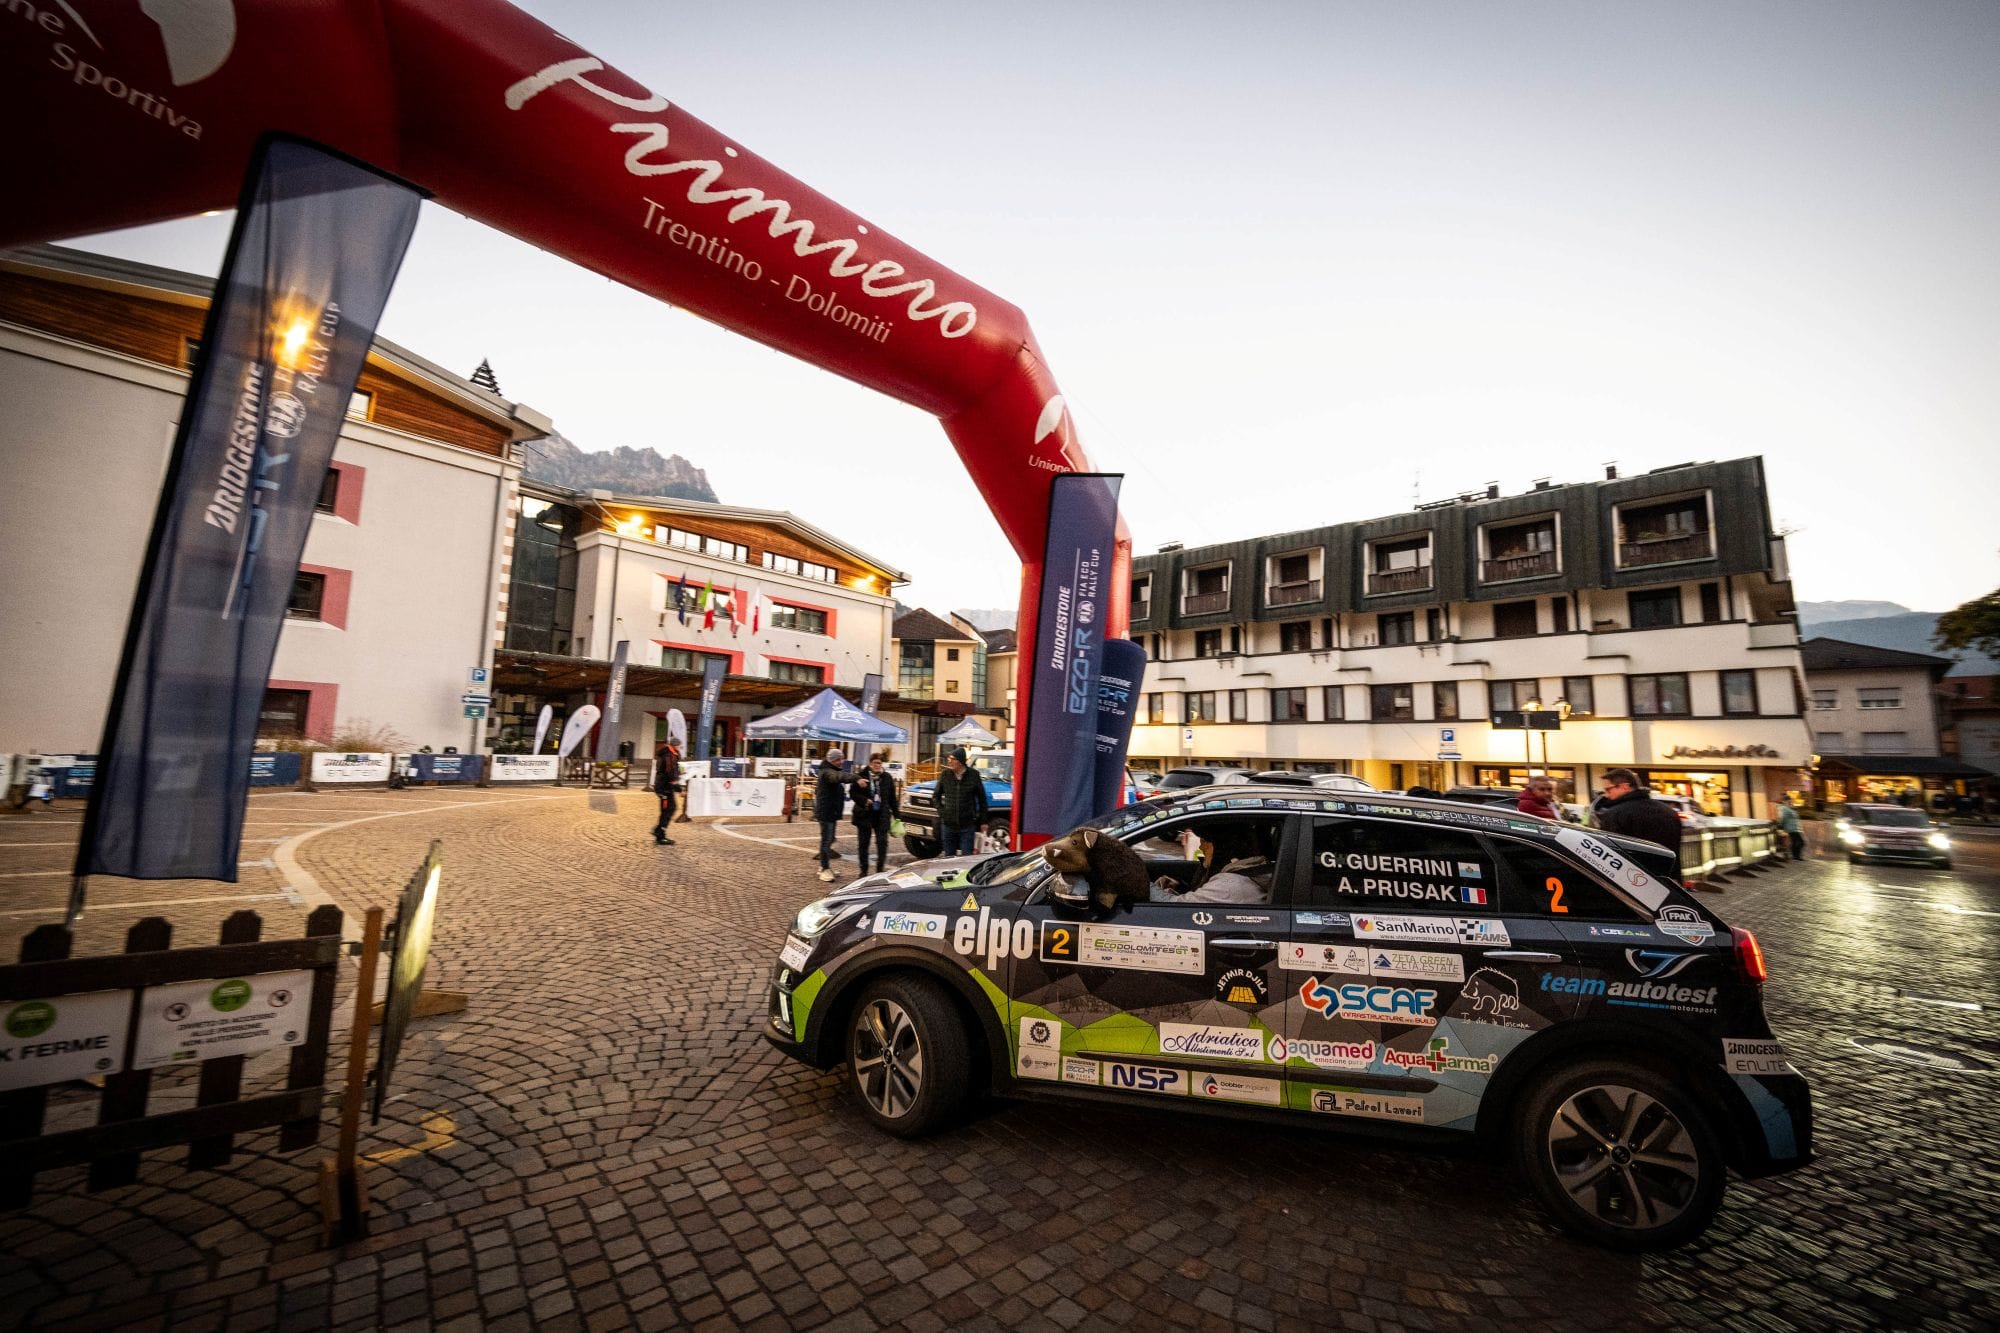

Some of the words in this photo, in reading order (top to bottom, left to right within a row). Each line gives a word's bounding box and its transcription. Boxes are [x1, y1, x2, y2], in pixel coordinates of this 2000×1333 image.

[50, 42, 203, 140] Sportiva
[505, 34, 978, 338] Primiero
[642, 197, 763, 282] Trentino
[785, 274, 894, 343] Dolomiti
[319, 302, 341, 337] CUP
[1028, 454, 1071, 473] Unione
[1080, 561, 1090, 579] ECO
[1091, 549, 1100, 567] CUP
[1078, 582, 1088, 597] FIA
[1087, 570, 1099, 598] RALLY
[1077, 600, 1094, 624] FIA
[1051, 585, 1071, 671] BRIDGESTONE
[1069, 627, 1093, 715] ECO-R
[1320, 851, 1342, 869] G.
[1346, 853, 1453, 877] GUERRINI
[1580, 837, 1624, 871] sara
[1338, 876, 1359, 894] A.
[1363, 878, 1457, 903] PRUSAK
[1545, 877, 1569, 913] 2
[883, 916, 937, 934] TRENTINO
[1375, 920, 1455, 935] SanMarino
[1668, 911, 1692, 921] FPAK
[953, 905, 1034, 971] elpo
[1051, 928, 1070, 955] 2
[1474, 932, 1508, 943] FAMS
[1217, 968, 1245, 992] JETMIR
[1245, 970, 1267, 995] DJILA
[1540, 972, 1606, 996] team
[1607, 980, 1719, 1006] autotest
[1341, 985, 1435, 1016] SCAF
[1670, 1004, 1718, 1015] motorsport
[1342, 1012, 1405, 1022] INFRASTRUCTURE
[21, 1035, 110, 1059] FERME
[1163, 1027, 1260, 1053] Adriatica
[1288, 1042, 1374, 1060] aquamed
[1112, 1064, 1179, 1091] NSP
